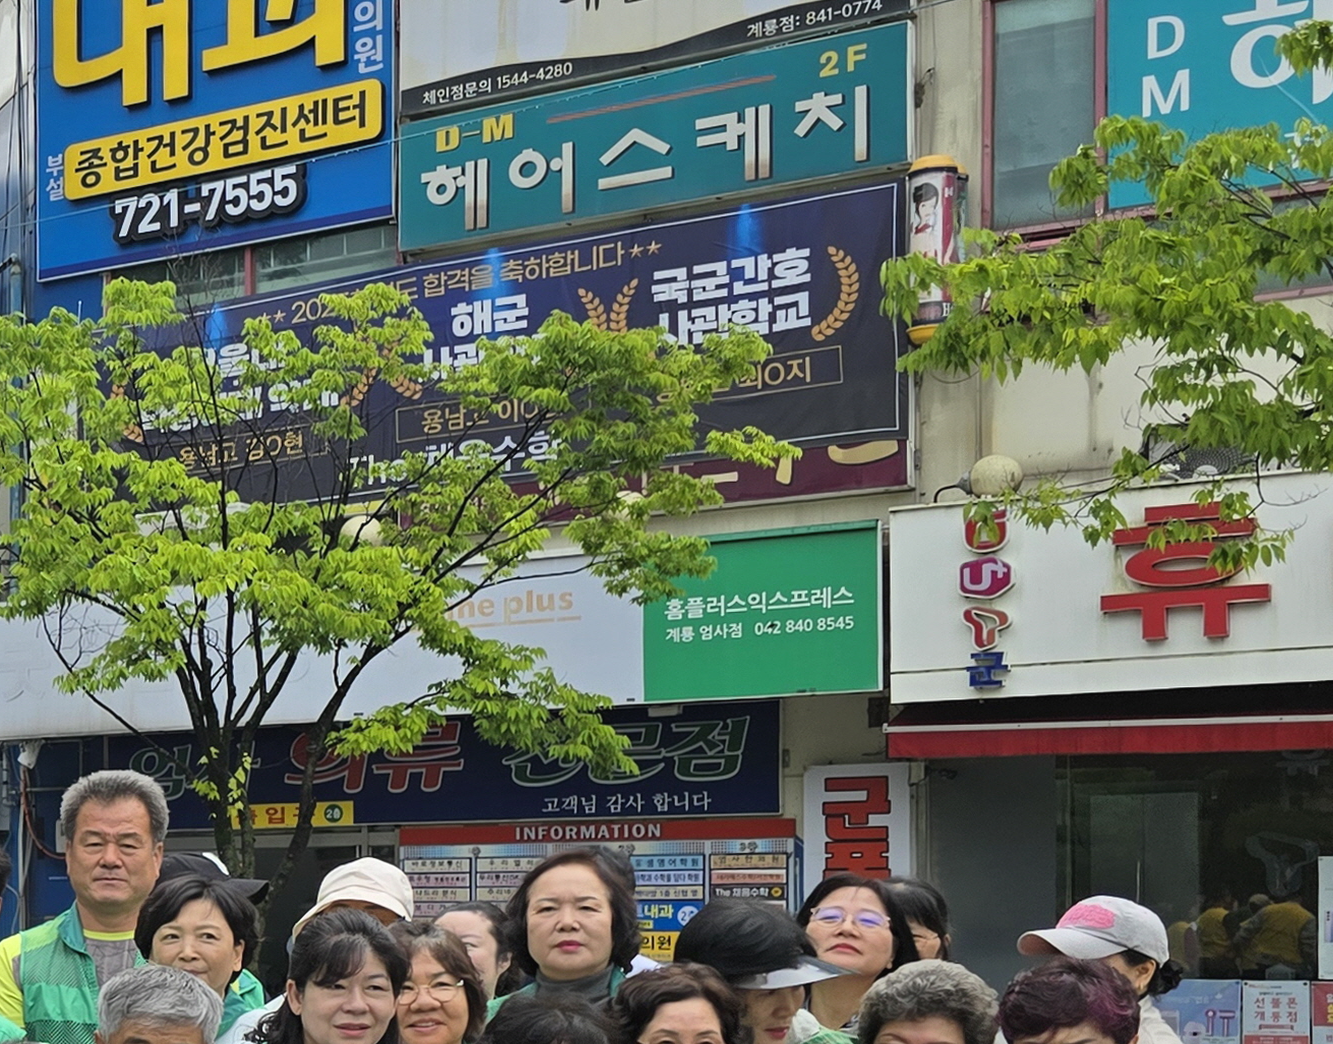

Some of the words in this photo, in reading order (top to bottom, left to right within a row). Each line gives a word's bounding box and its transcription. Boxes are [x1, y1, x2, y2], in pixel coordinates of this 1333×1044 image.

[746, 14, 802, 40] 계룡점:
[804, 0, 883, 26] 841-0774
[818, 43, 869, 79] 2F
[422, 76, 493, 107] 체인점문의
[496, 61, 573, 90] 1544-4280
[73, 89, 369, 189] 종합건강검진센터
[420, 84, 870, 232] 헤어스케치
[45, 152, 65, 203] 부설
[114, 163, 299, 239] 721-7555
[423, 265, 494, 299] 합격을
[499, 241, 626, 283] 축하합니다
[649, 246, 812, 304] 국군간호
[450, 293, 528, 338] 해군
[1100, 500, 1272, 641] 휴
[664, 585, 855, 621] 홈플러스익스프레스
[665, 626, 696, 644] 계룡
[700, 622, 743, 642] 엄사점
[754, 619, 782, 638] 042
[786, 617, 814, 635] 840
[817, 614, 855, 633] 8545
[541, 795, 598, 814] 고객님
[605, 793, 645, 813] 감사
[651, 791, 712, 812] 합니다
[514, 823, 662, 841] INFORMATION
[715, 887, 731, 897] The
